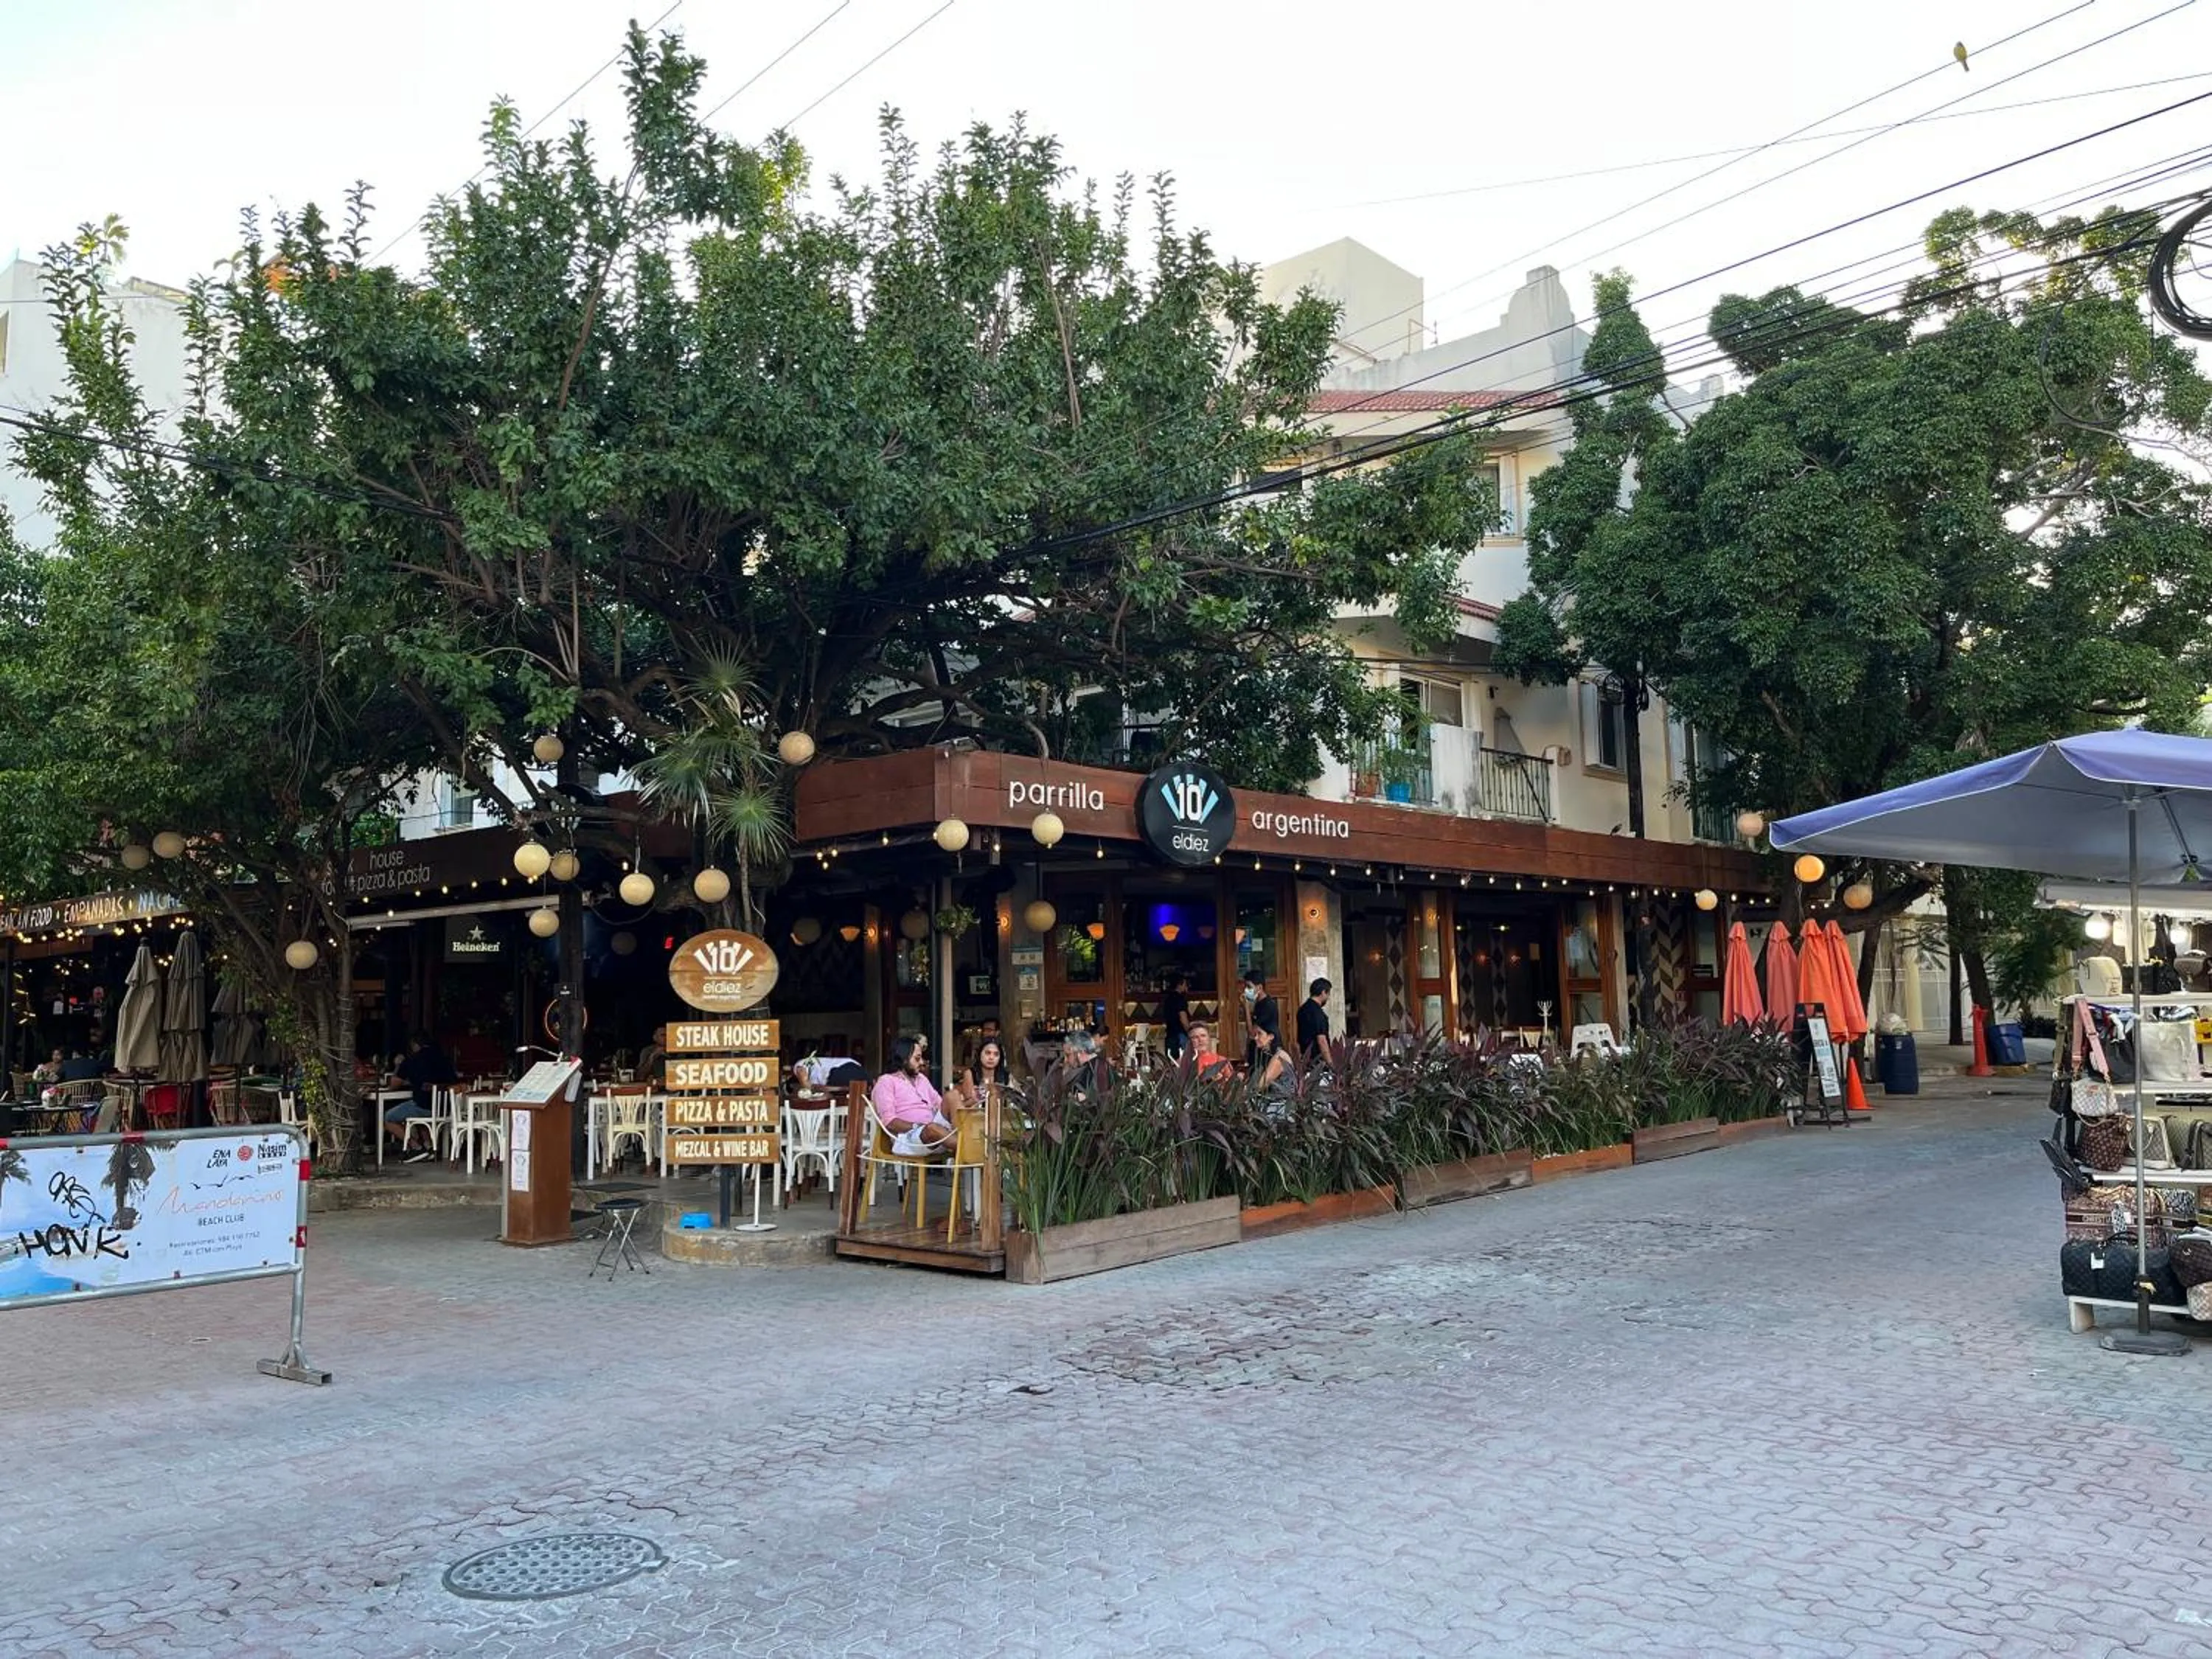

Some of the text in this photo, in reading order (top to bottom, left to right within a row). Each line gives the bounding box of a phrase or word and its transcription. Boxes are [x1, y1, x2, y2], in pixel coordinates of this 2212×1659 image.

[1009, 780, 1104, 810] parrilla
[1177, 782, 1203, 821] 10
[1252, 810, 1349, 838] argentina
[369, 850, 404, 870] house
[358, 873, 386, 894] pizza
[387, 869, 397, 888] &
[397, 863, 431, 891] pasta
[0, 909, 29, 931] EXICAN
[30, 906, 52, 928] FOOD
[453, 942, 500, 952] Heineken
[710, 947, 736, 973] 10
[676, 1024, 769, 1047] STEAK HOUSE
[675, 1062, 768, 1085] SEAFOOD
[675, 1100, 768, 1122] PIZZA & PASTA
[675, 1140, 769, 1158] MEZCAL & WINE BAR
[198, 1214, 245, 1227] BEACH CLUB
